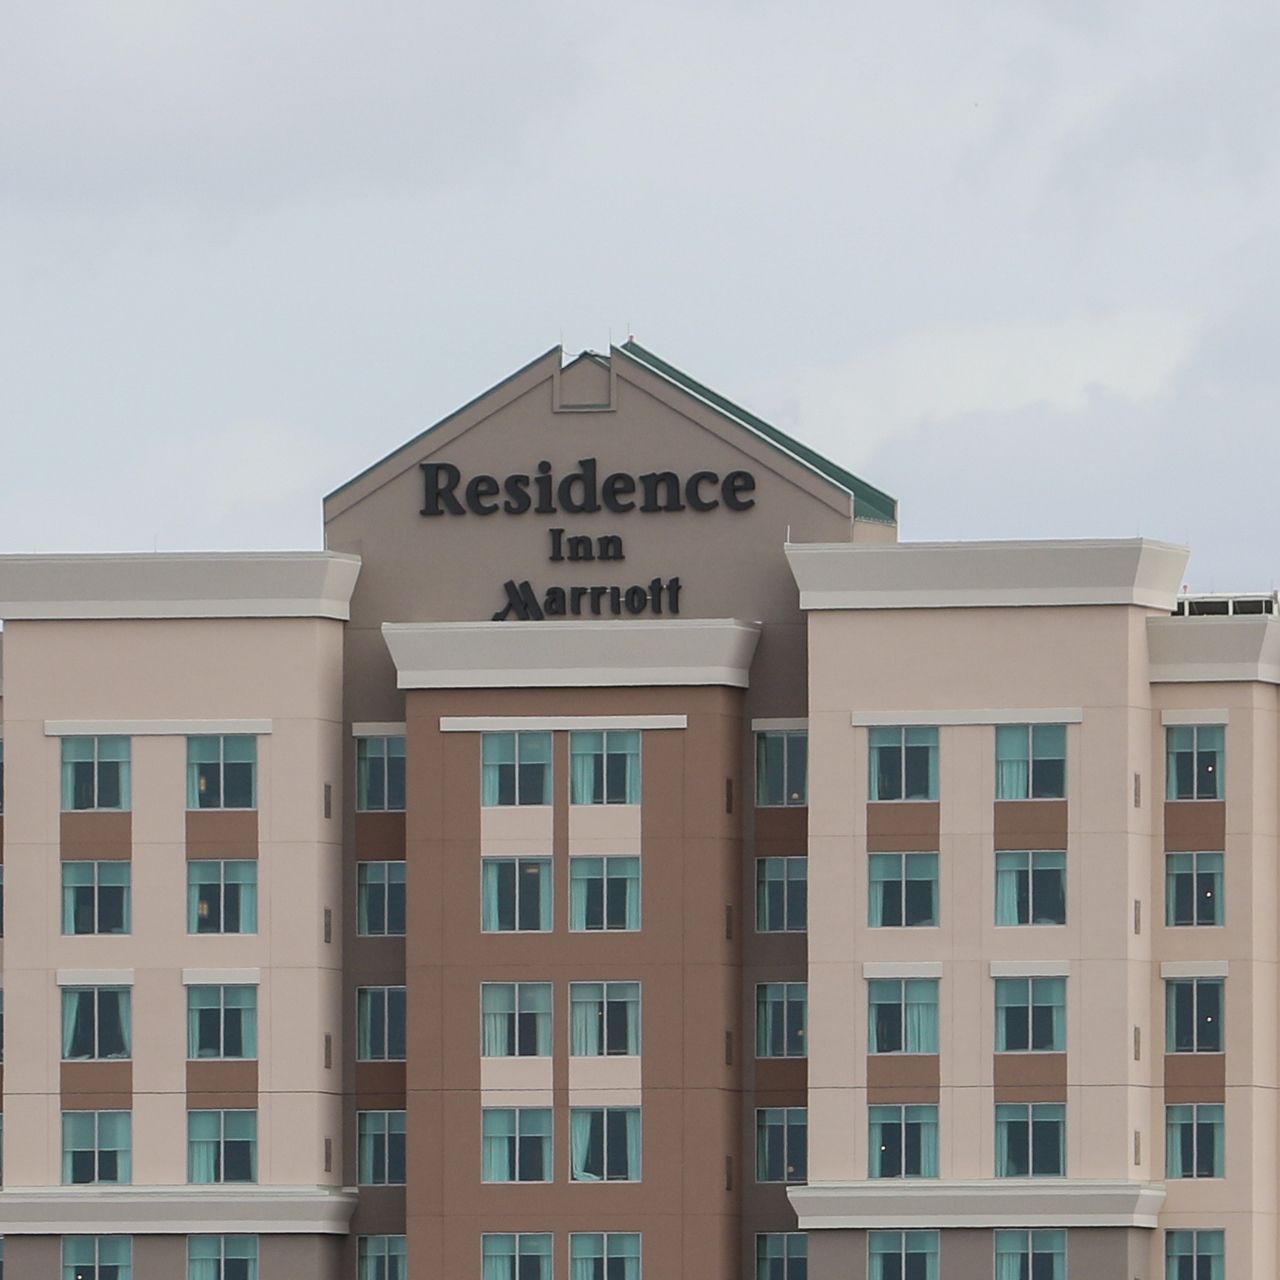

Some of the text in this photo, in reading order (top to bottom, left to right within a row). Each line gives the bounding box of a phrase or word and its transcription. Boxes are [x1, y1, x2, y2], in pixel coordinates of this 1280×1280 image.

[420, 458, 757, 517] Residence
[549, 528, 624, 562] Inn
[491, 576, 682, 621] Marriott
